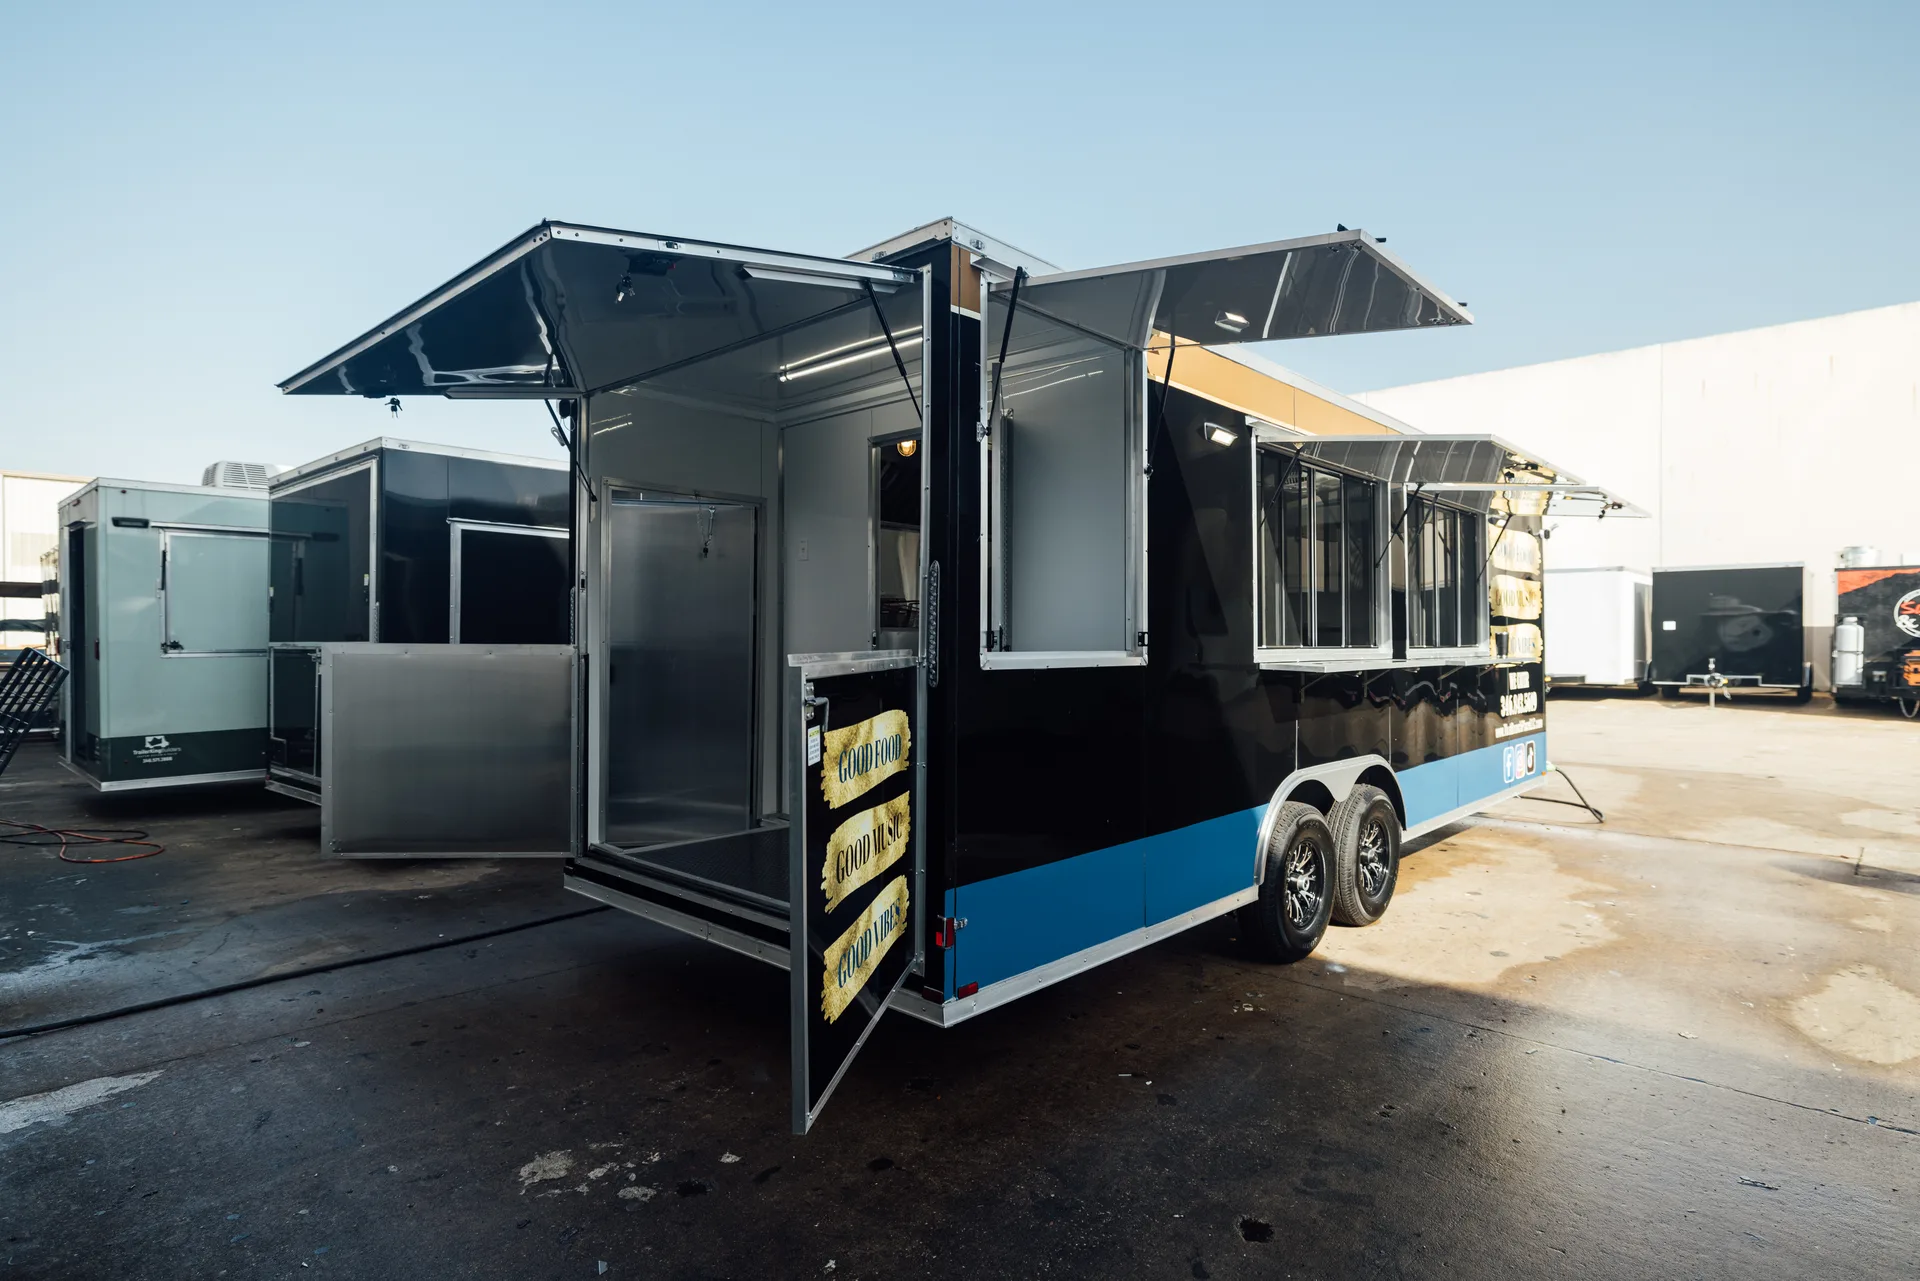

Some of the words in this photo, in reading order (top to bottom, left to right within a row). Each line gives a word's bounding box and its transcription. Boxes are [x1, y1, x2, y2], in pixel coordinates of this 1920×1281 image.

[1495, 589, 1515, 606] GOOD
[838, 739, 873, 784] GOOD
[874, 733, 902, 769] FOOD
[835, 833, 870, 884] GOOD
[871, 811, 903, 858] MUSIC
[837, 938, 872, 989] GOOD
[873, 897, 901, 948] VIBES
